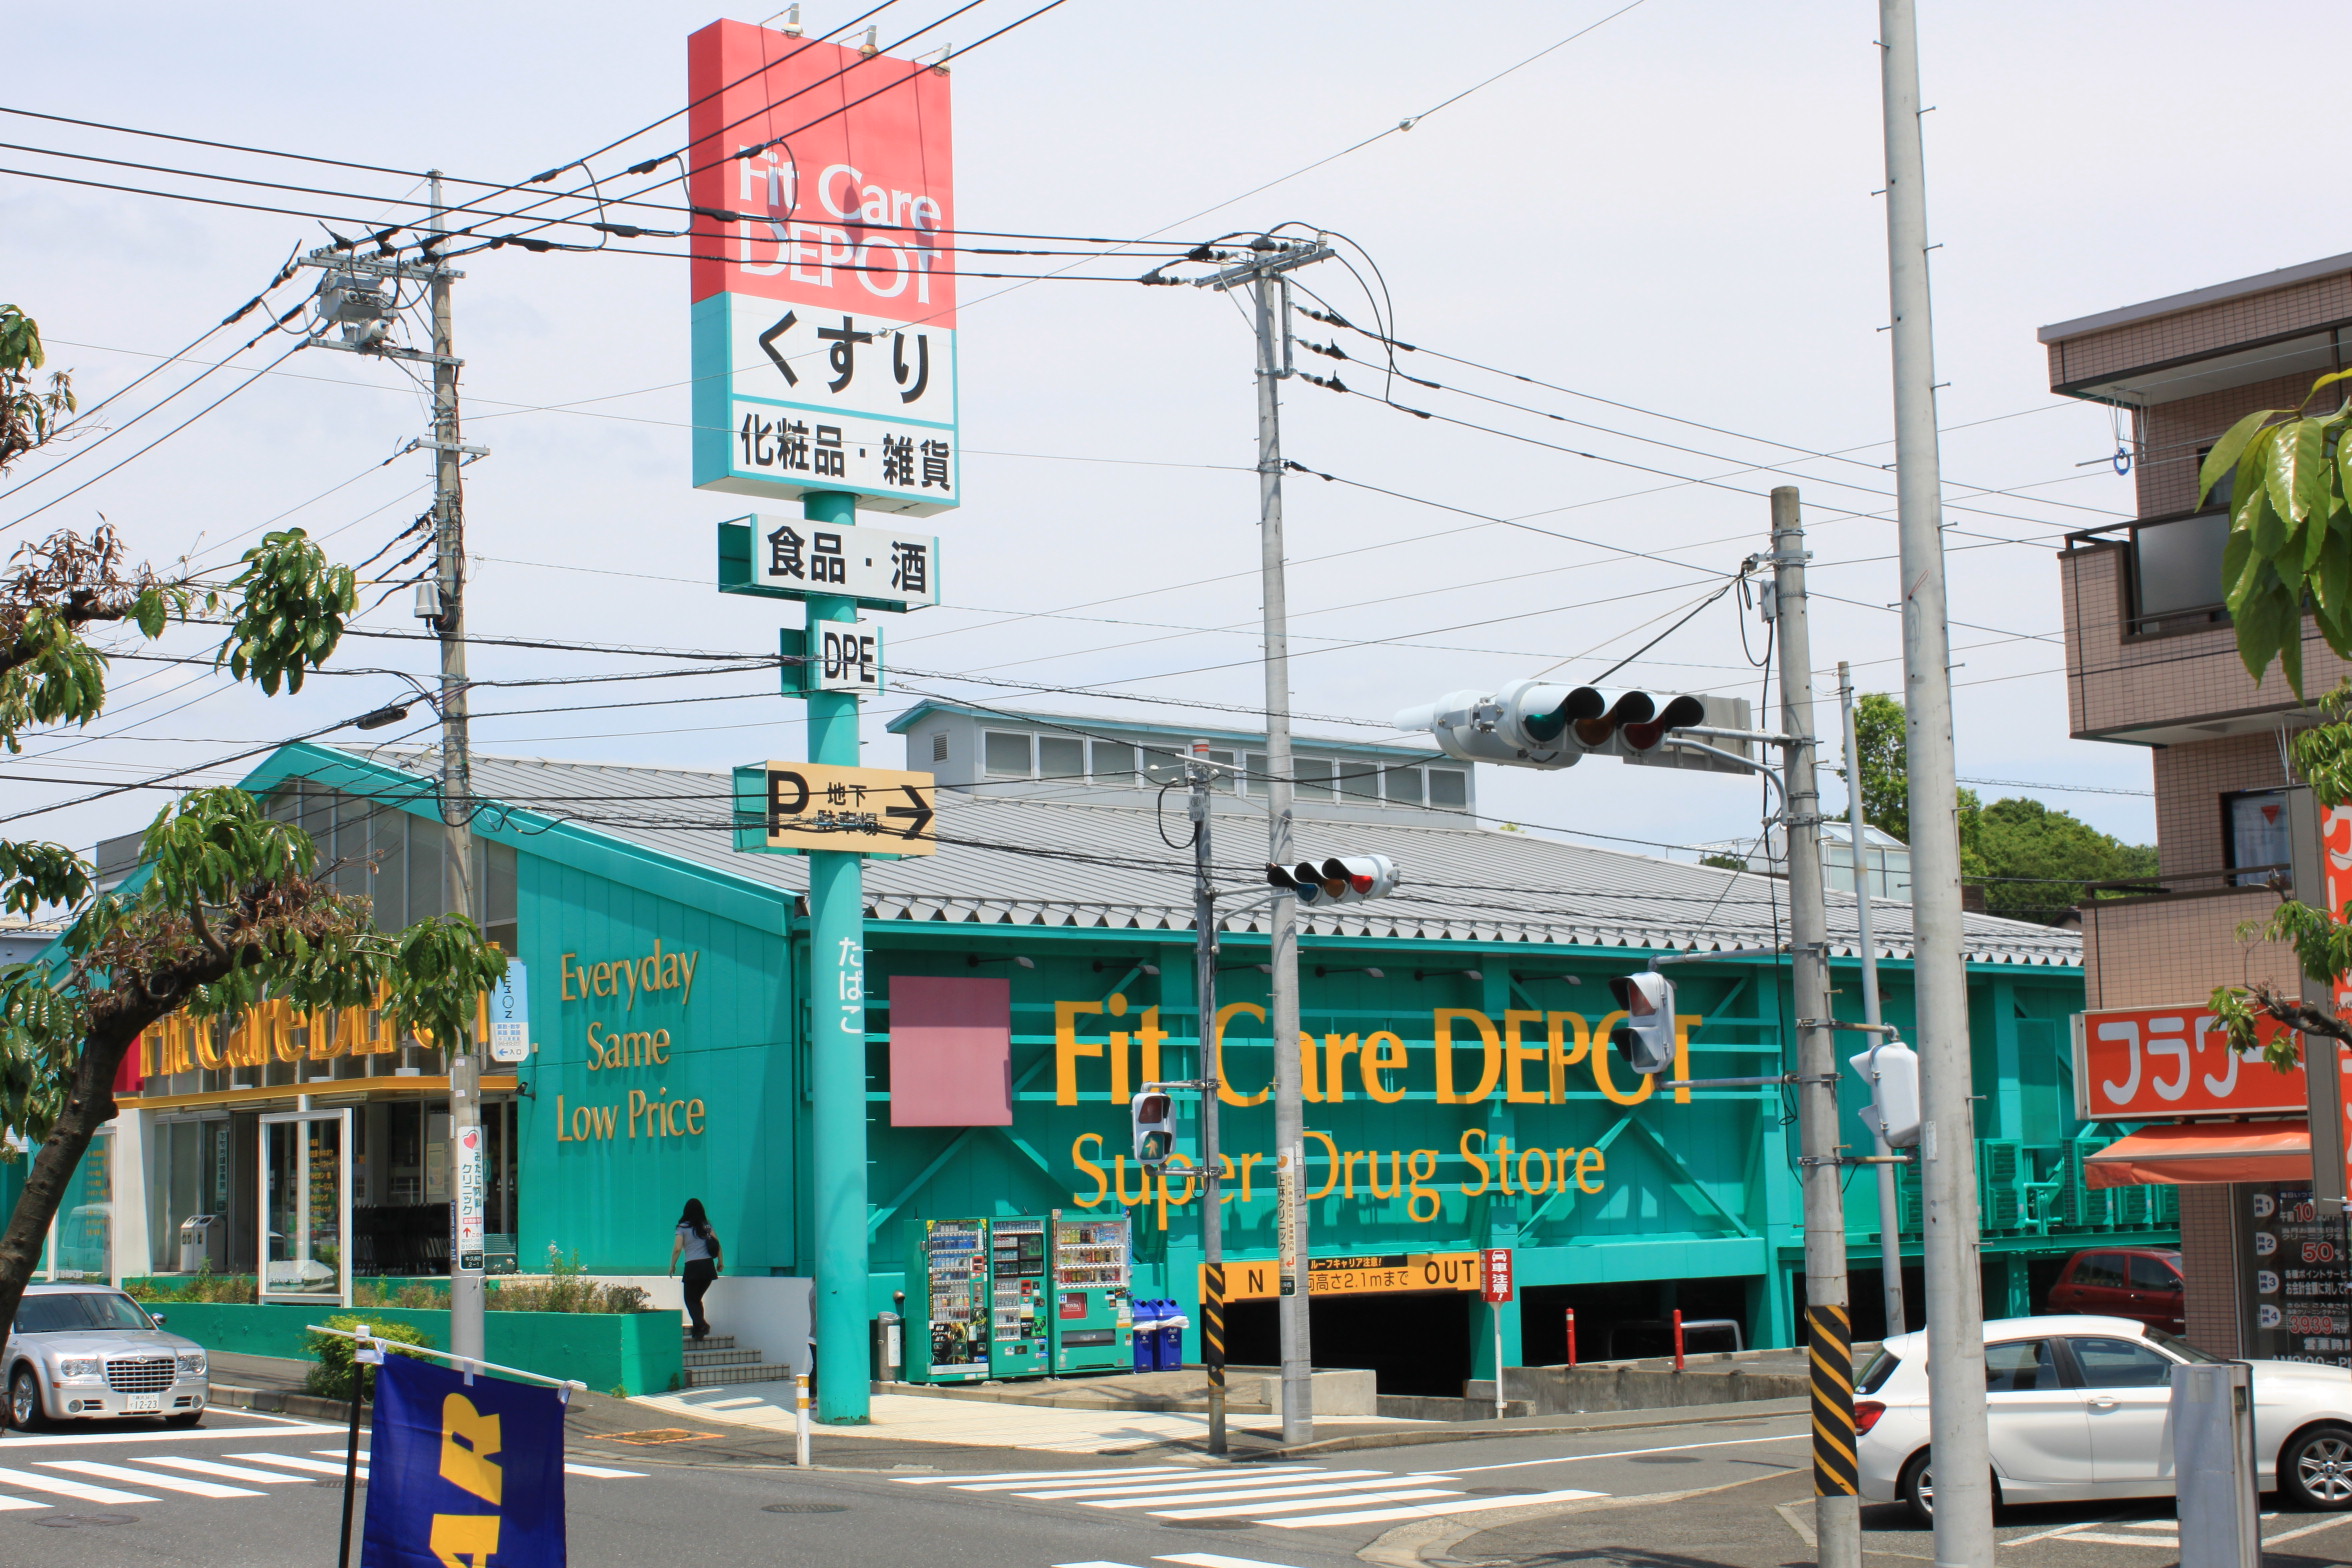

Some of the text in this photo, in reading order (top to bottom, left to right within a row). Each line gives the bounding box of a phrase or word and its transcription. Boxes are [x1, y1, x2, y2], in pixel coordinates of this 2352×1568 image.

[738, 144, 942, 237] Fit Care
[740, 210, 942, 304] DEPOT
[758, 309, 929, 404] くすり
[741, 412, 951, 491] 化粧品・雑貨
[767, 525, 927, 594] 食品・酒
[824, 631, 875, 684] DPE
[768, 770, 810, 838] P
[828, 781, 867, 807] 地下
[560, 938, 699, 1011] Everyday
[838, 936, 863, 1034] たばこ
[587, 1021, 671, 1071] Same
[1055, 992, 1703, 1107] Fit Care DEPOT
[556, 1086, 706, 1142] Low Price
[462, 1164, 473, 1215] クリニック
[1071, 1127, 1605, 1231] Super Drug Store
[1424, 1260, 1475, 1284] OUT
